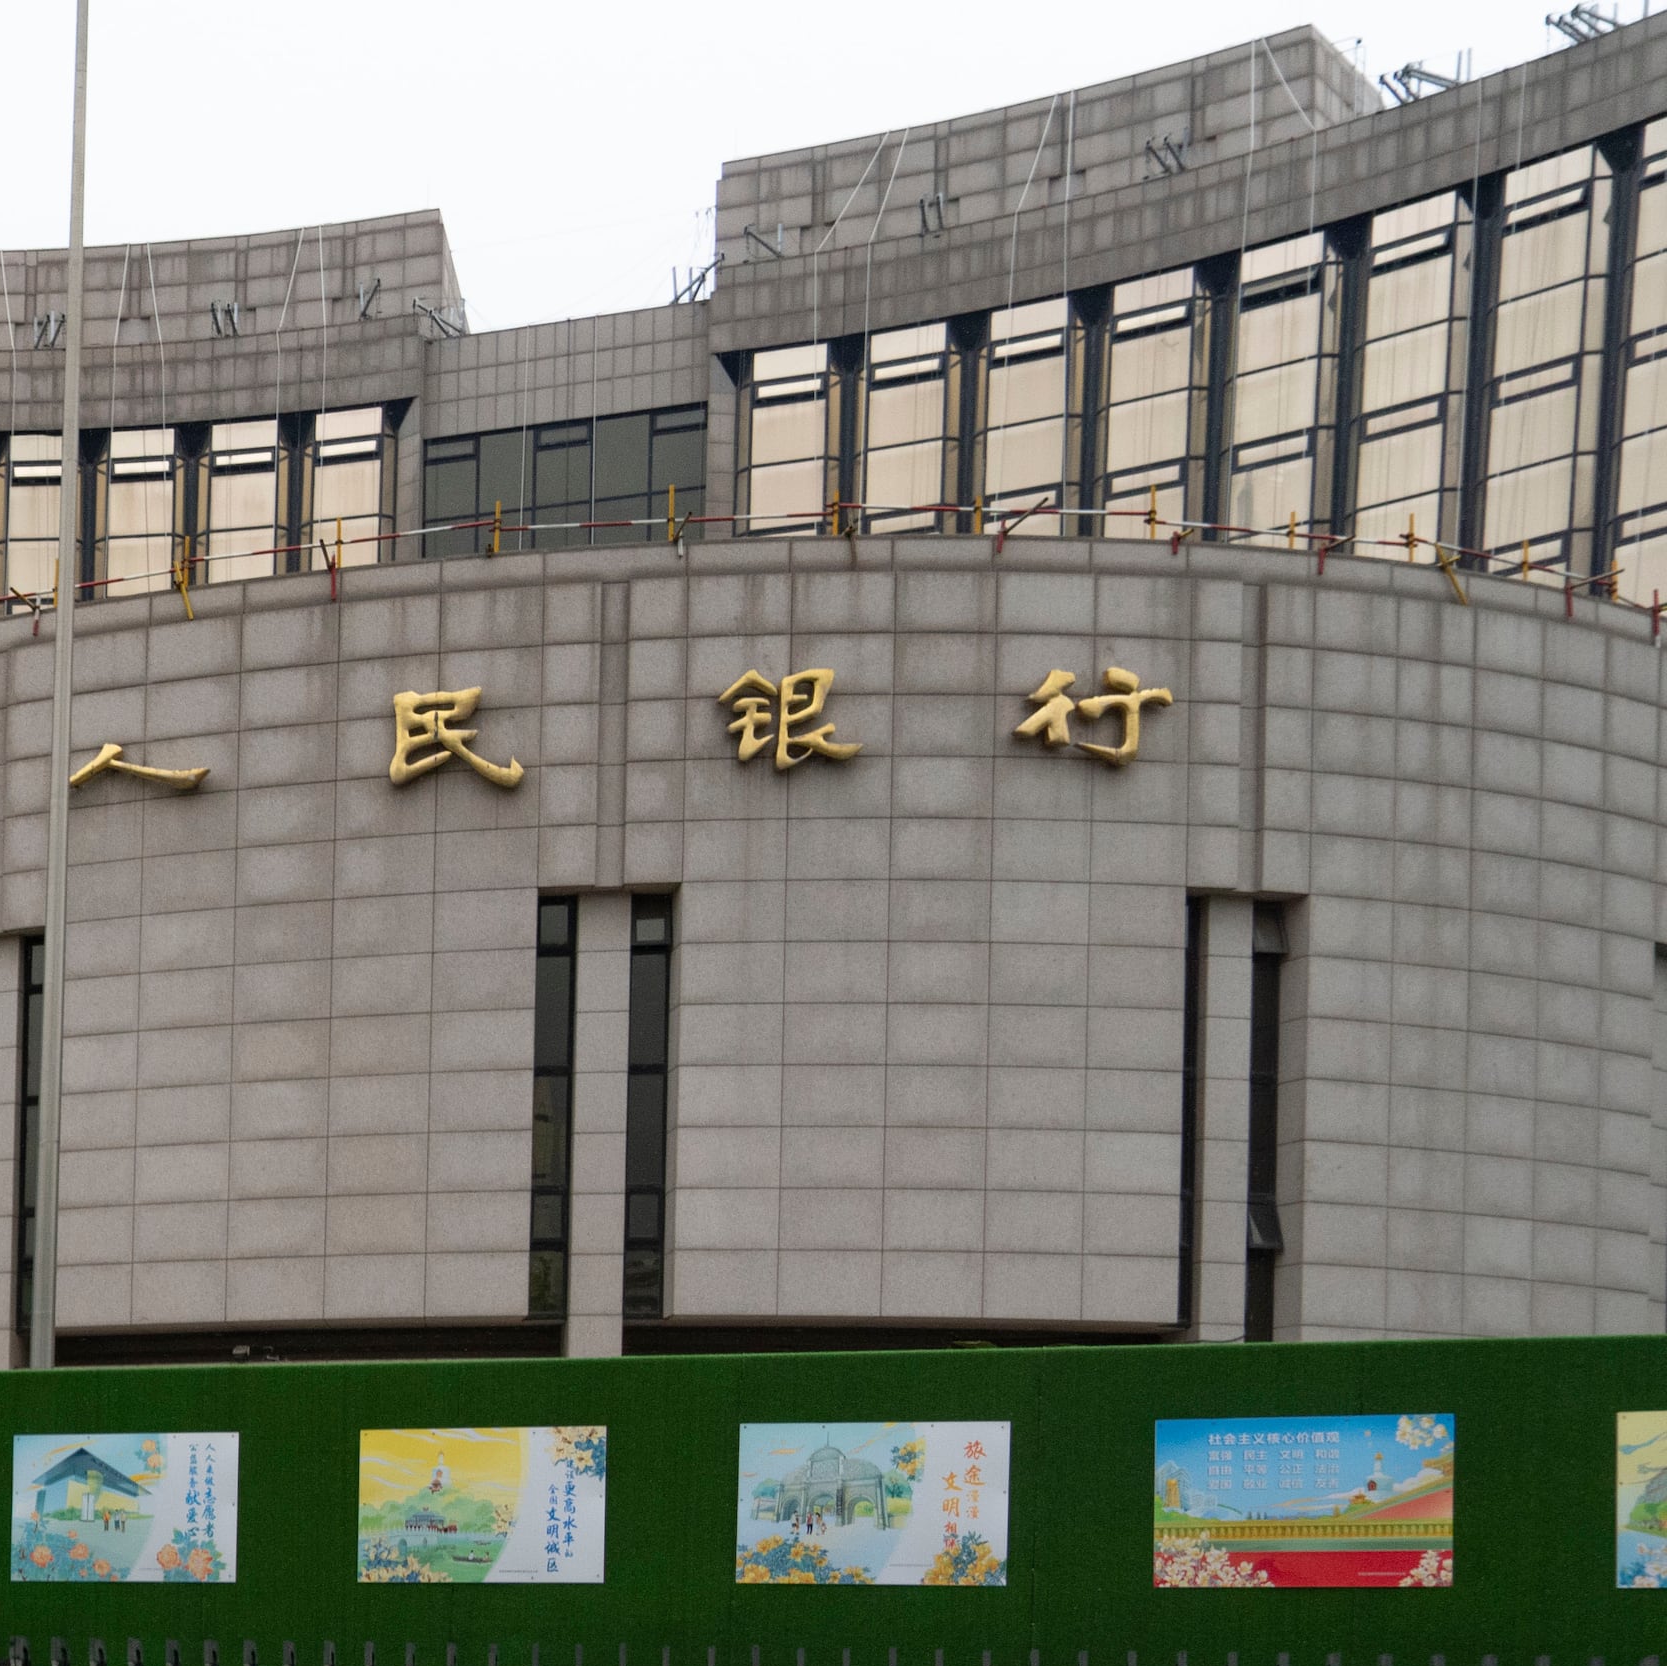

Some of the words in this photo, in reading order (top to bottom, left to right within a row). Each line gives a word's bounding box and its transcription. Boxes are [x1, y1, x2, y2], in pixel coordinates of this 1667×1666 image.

[1208, 1431, 1340, 1446] 社会主义核心价值观
